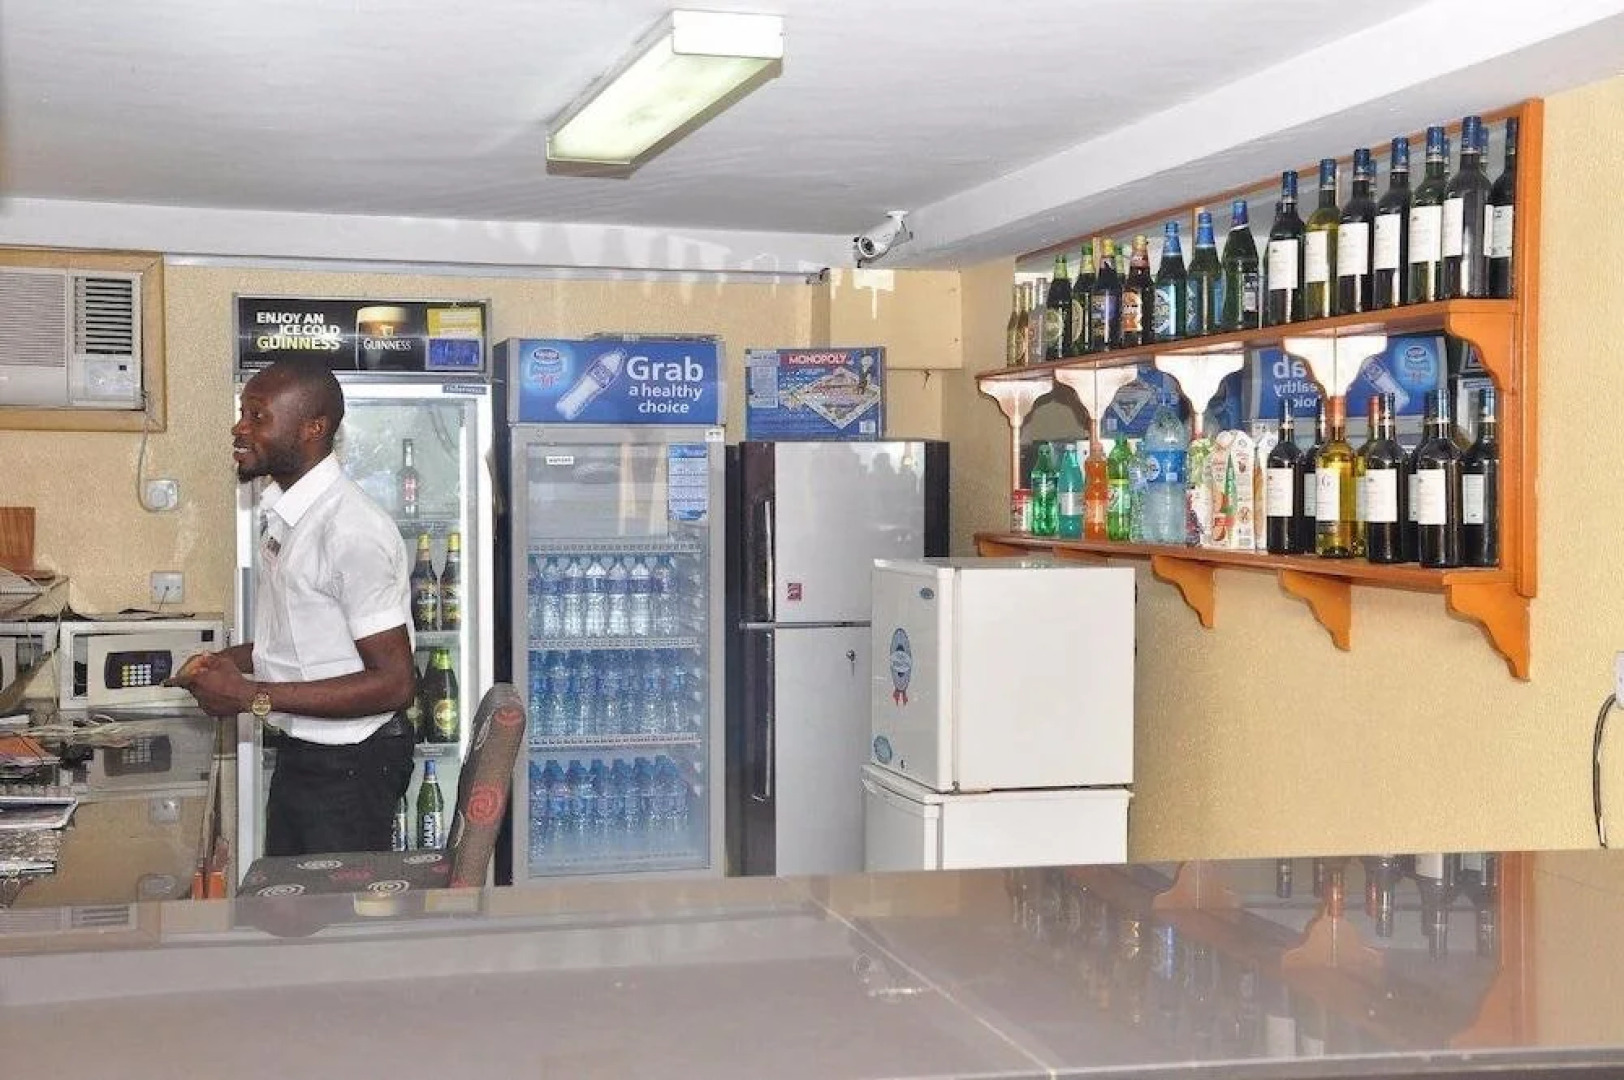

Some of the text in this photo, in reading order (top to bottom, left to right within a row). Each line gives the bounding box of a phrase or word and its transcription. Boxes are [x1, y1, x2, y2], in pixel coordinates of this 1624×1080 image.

[256, 312, 324, 324] ENJOY AN
[279, 324, 341, 336] ICE COLD
[257, 335, 341, 350] GUINNESS
[363, 337, 412, 351] GUINNESS
[788, 353, 847, 365] MONOPOLY
[626, 355, 704, 382] Grab
[628, 382, 703, 402] a healthy
[638, 399, 690, 414] choice
[423, 813, 434, 847] HARP
